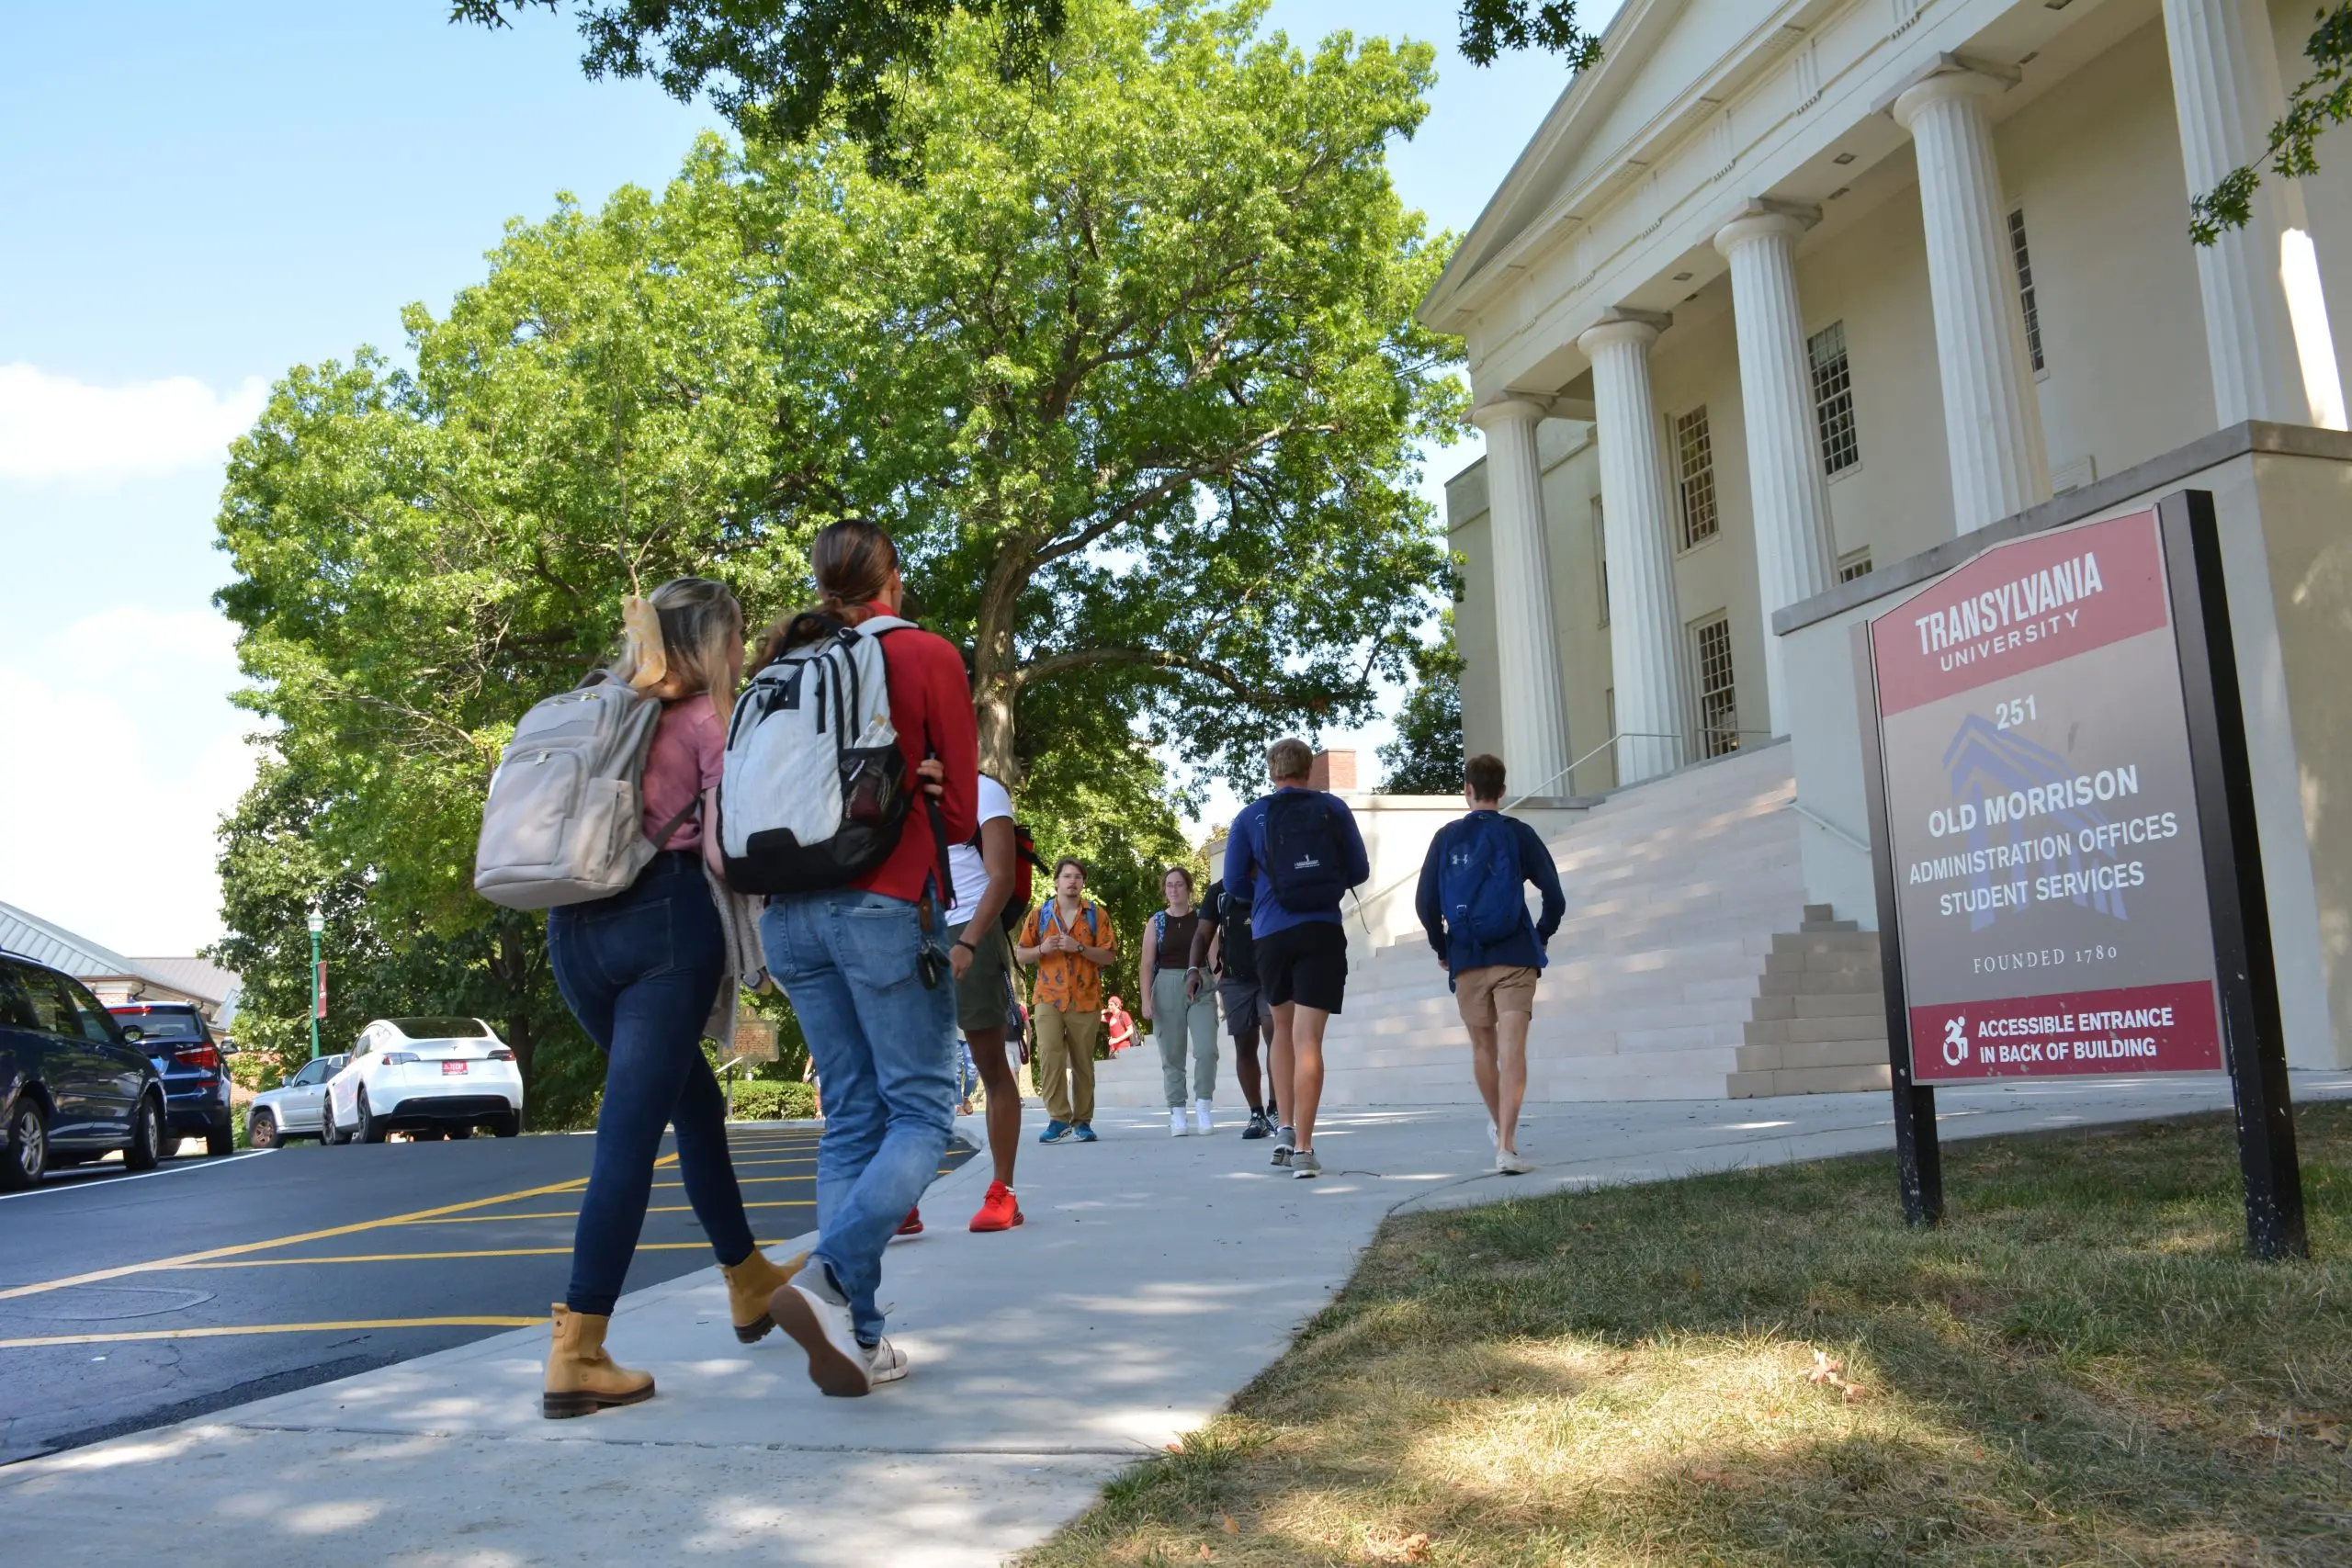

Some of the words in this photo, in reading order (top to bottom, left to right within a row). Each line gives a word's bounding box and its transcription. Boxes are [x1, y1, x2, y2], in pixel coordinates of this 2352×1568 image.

[1916, 551, 2102, 655] TRANSYLVANIA
[1940, 609, 2079, 671] UNIVERSITY
[1996, 694, 2036, 730] 251
[1928, 805, 1977, 838] OLD
[1984, 764, 2138, 825] MORRISON
[1910, 832, 2072, 885] ADMINISTRATION
[2079, 811, 2177, 852] OFFICES
[1940, 880, 2028, 916] STUDENT
[2036, 861, 2144, 900] SERVICES
[1974, 947, 2064, 974] FOUNDED
[2076, 944, 2117, 963] 1780
[1978, 1014, 2075, 1038] ACCESSIBLE
[2079, 1007, 2173, 1032] ENTRANCE
[1980, 1045, 1995, 1064] IN
[2000, 1043, 2043, 1063] BACK
[2046, 1042, 2068, 1060] OF
[2074, 1037, 2156, 1059] BUILDING
